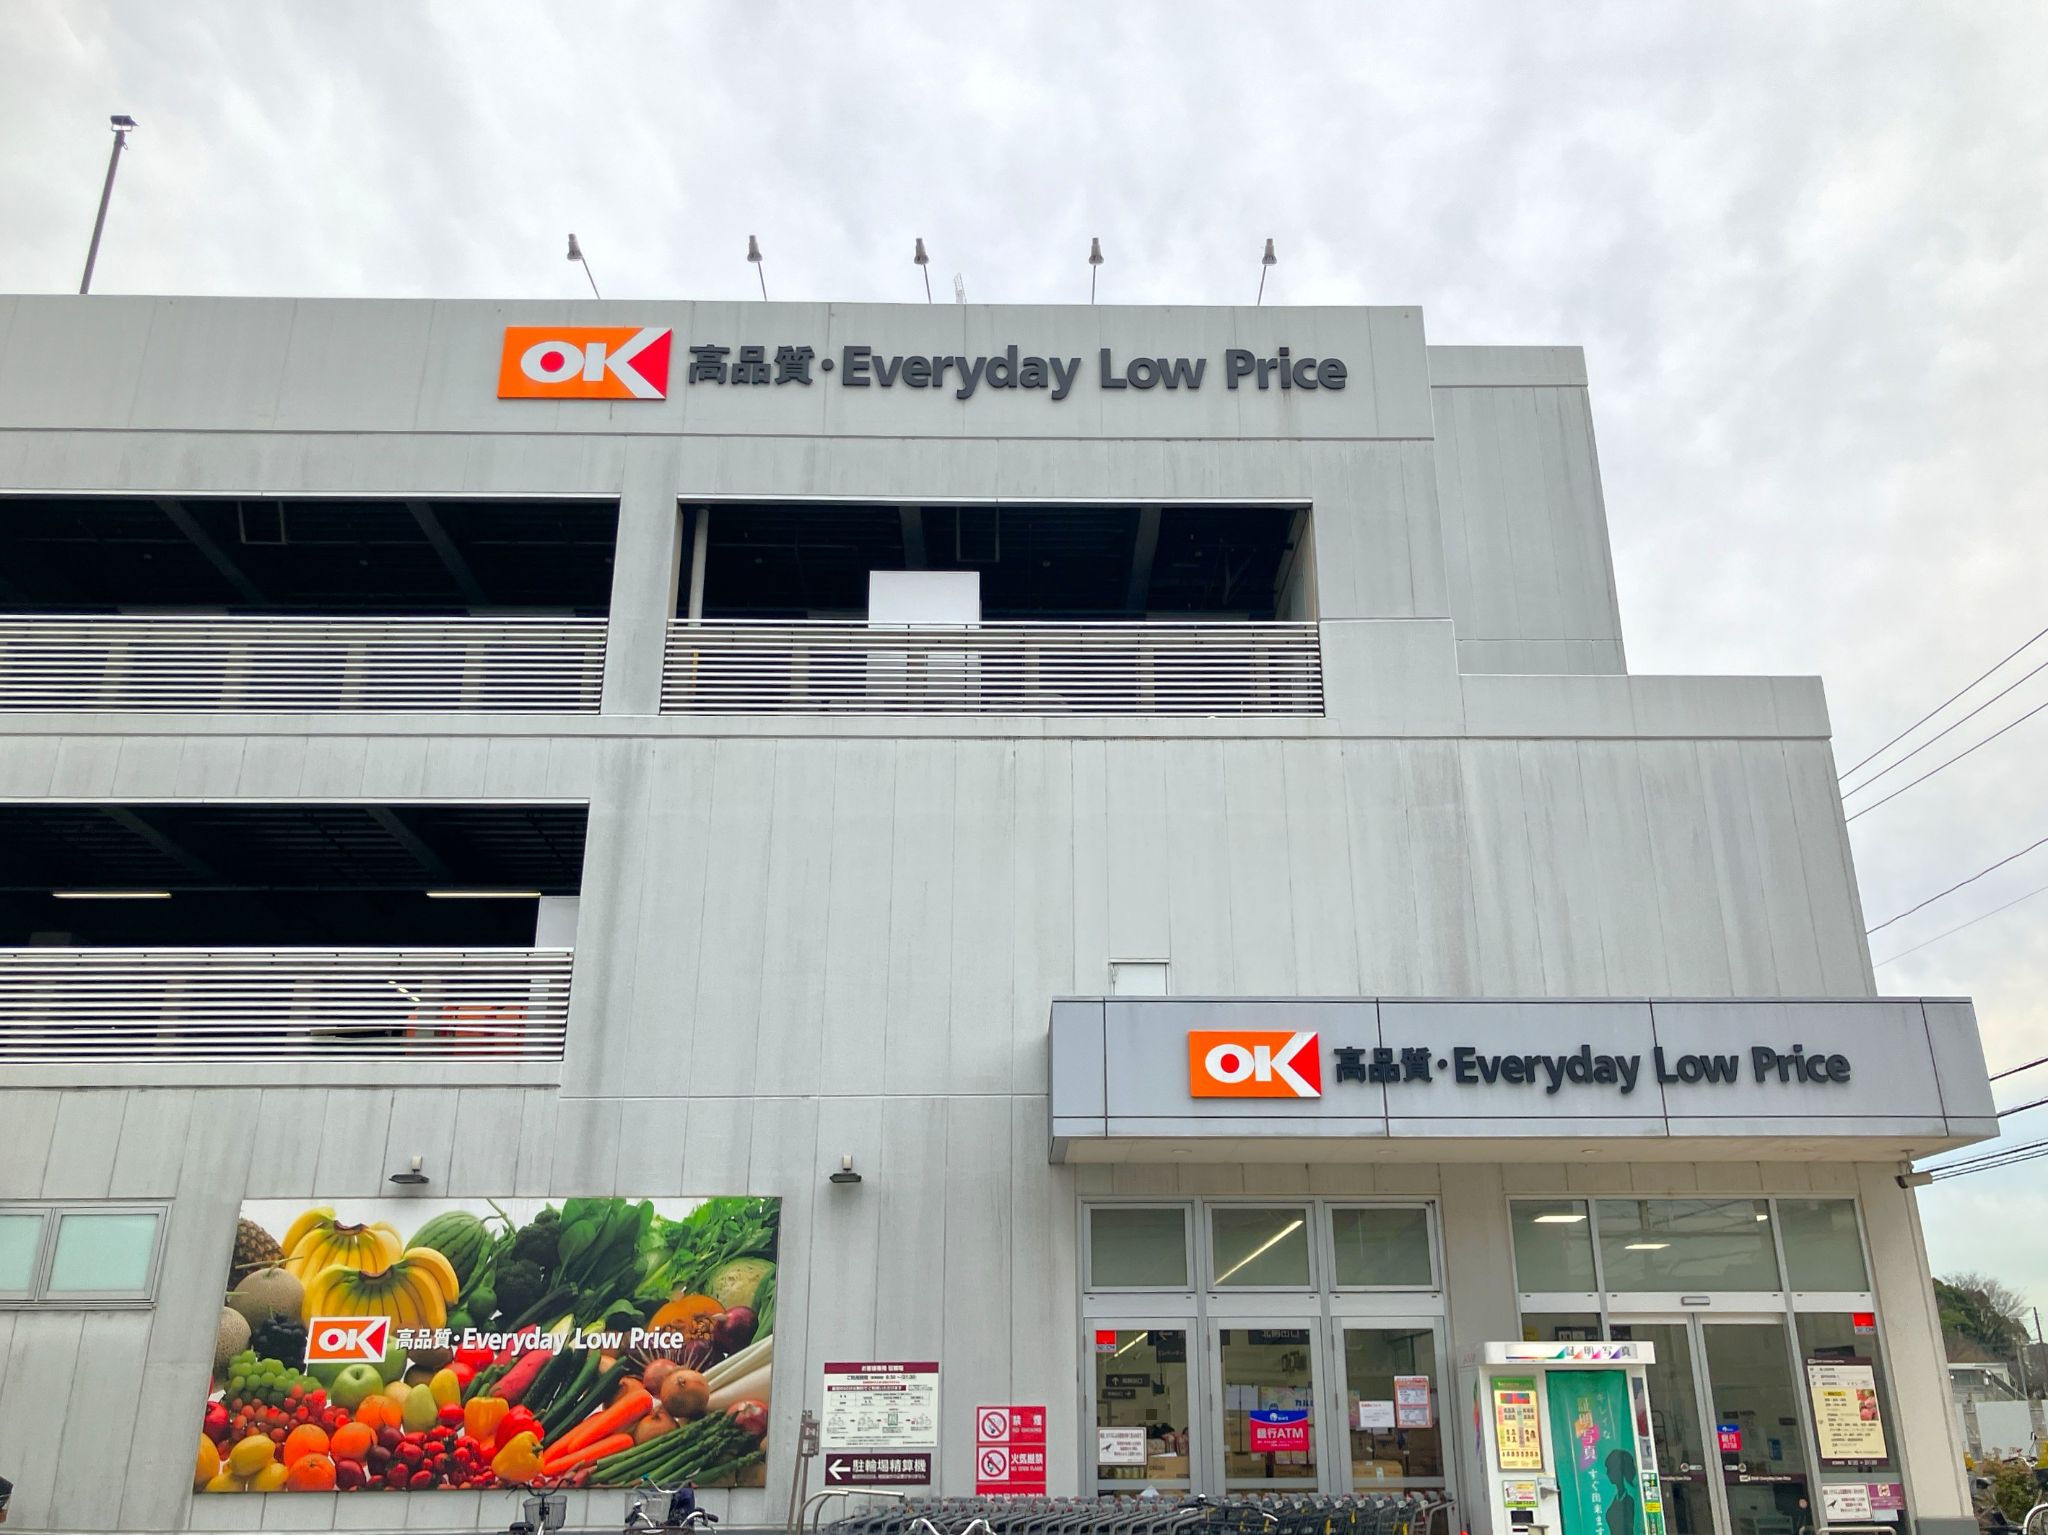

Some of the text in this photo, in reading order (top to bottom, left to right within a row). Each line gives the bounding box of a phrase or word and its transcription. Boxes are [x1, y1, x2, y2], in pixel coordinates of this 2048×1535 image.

[520, 326, 672, 399] OK
[1101, 349, 1206, 390] Low
[1226, 346, 1347, 391] Price
[1205, 1031, 1321, 1097] OK
[1654, 1046, 1738, 1084] Low
[1752, 1044, 1851, 1083] Price
[318, 1320, 388, 1361] OK
[574, 1328, 622, 1349] Low
[630, 1327, 683, 1350] Price
[1256, 1428, 1304, 1439] 銀行ATM
